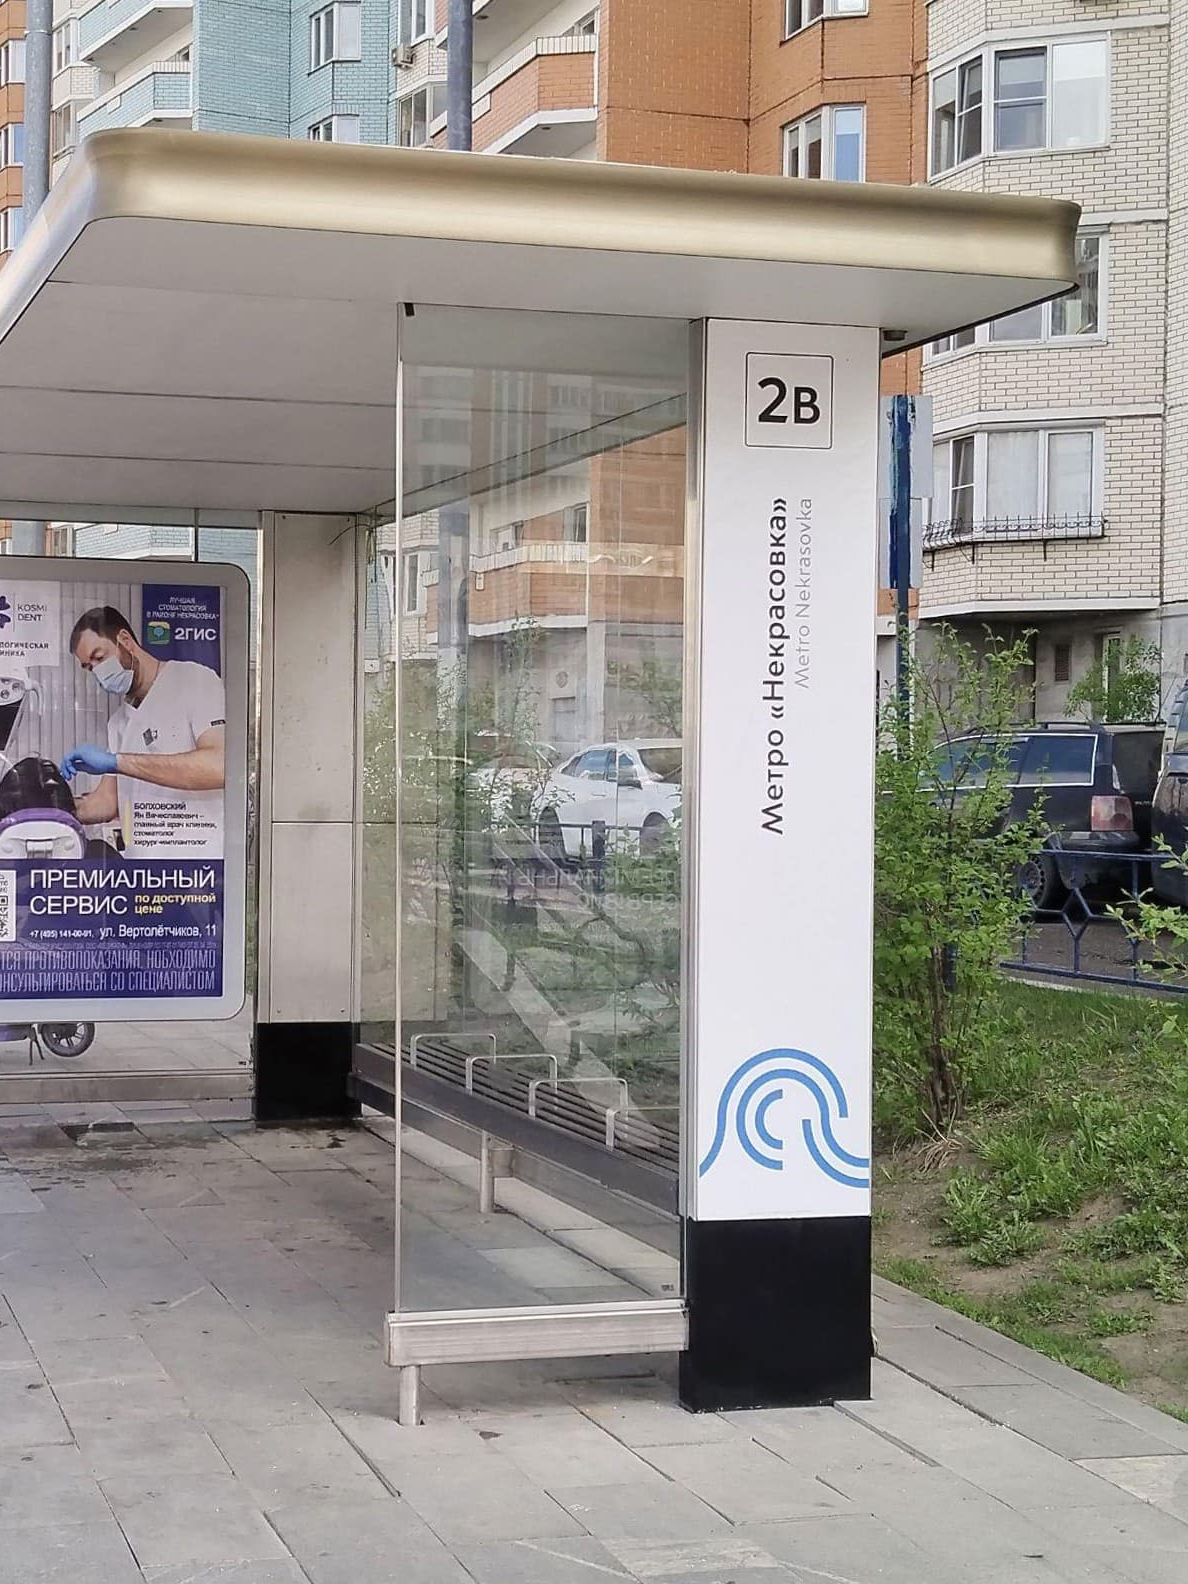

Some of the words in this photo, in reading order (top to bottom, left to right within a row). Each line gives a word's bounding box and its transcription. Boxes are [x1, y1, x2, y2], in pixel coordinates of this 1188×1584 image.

[794, 498, 813, 617] Nekrasovka
[17, 603, 48, 612] KOSMI
[17, 613, 43, 621] DENT
[762, 497, 791, 719] «Некрасовка»
[174, 627, 218, 641] 2ГИС
[794, 624, 810, 689] Metro
[762, 729, 789, 835] Метро
[29, 865, 216, 889] ПРЕМИАЛЬНЫЙ
[29, 895, 128, 915] СЕРВИС
[134, 895, 149, 903] по
[152, 893, 217, 905] доступной
[134, 904, 164, 915] цене
[29, 929, 40, 938] +7
[99, 926, 116, 941] ул.
[118, 924, 202, 940] Вертолётчиков,
[205, 924, 217, 936] 11
[111, 970, 125, 991] СО
[128, 970, 215, 992] СПЕЦИАЛИСТОМ
